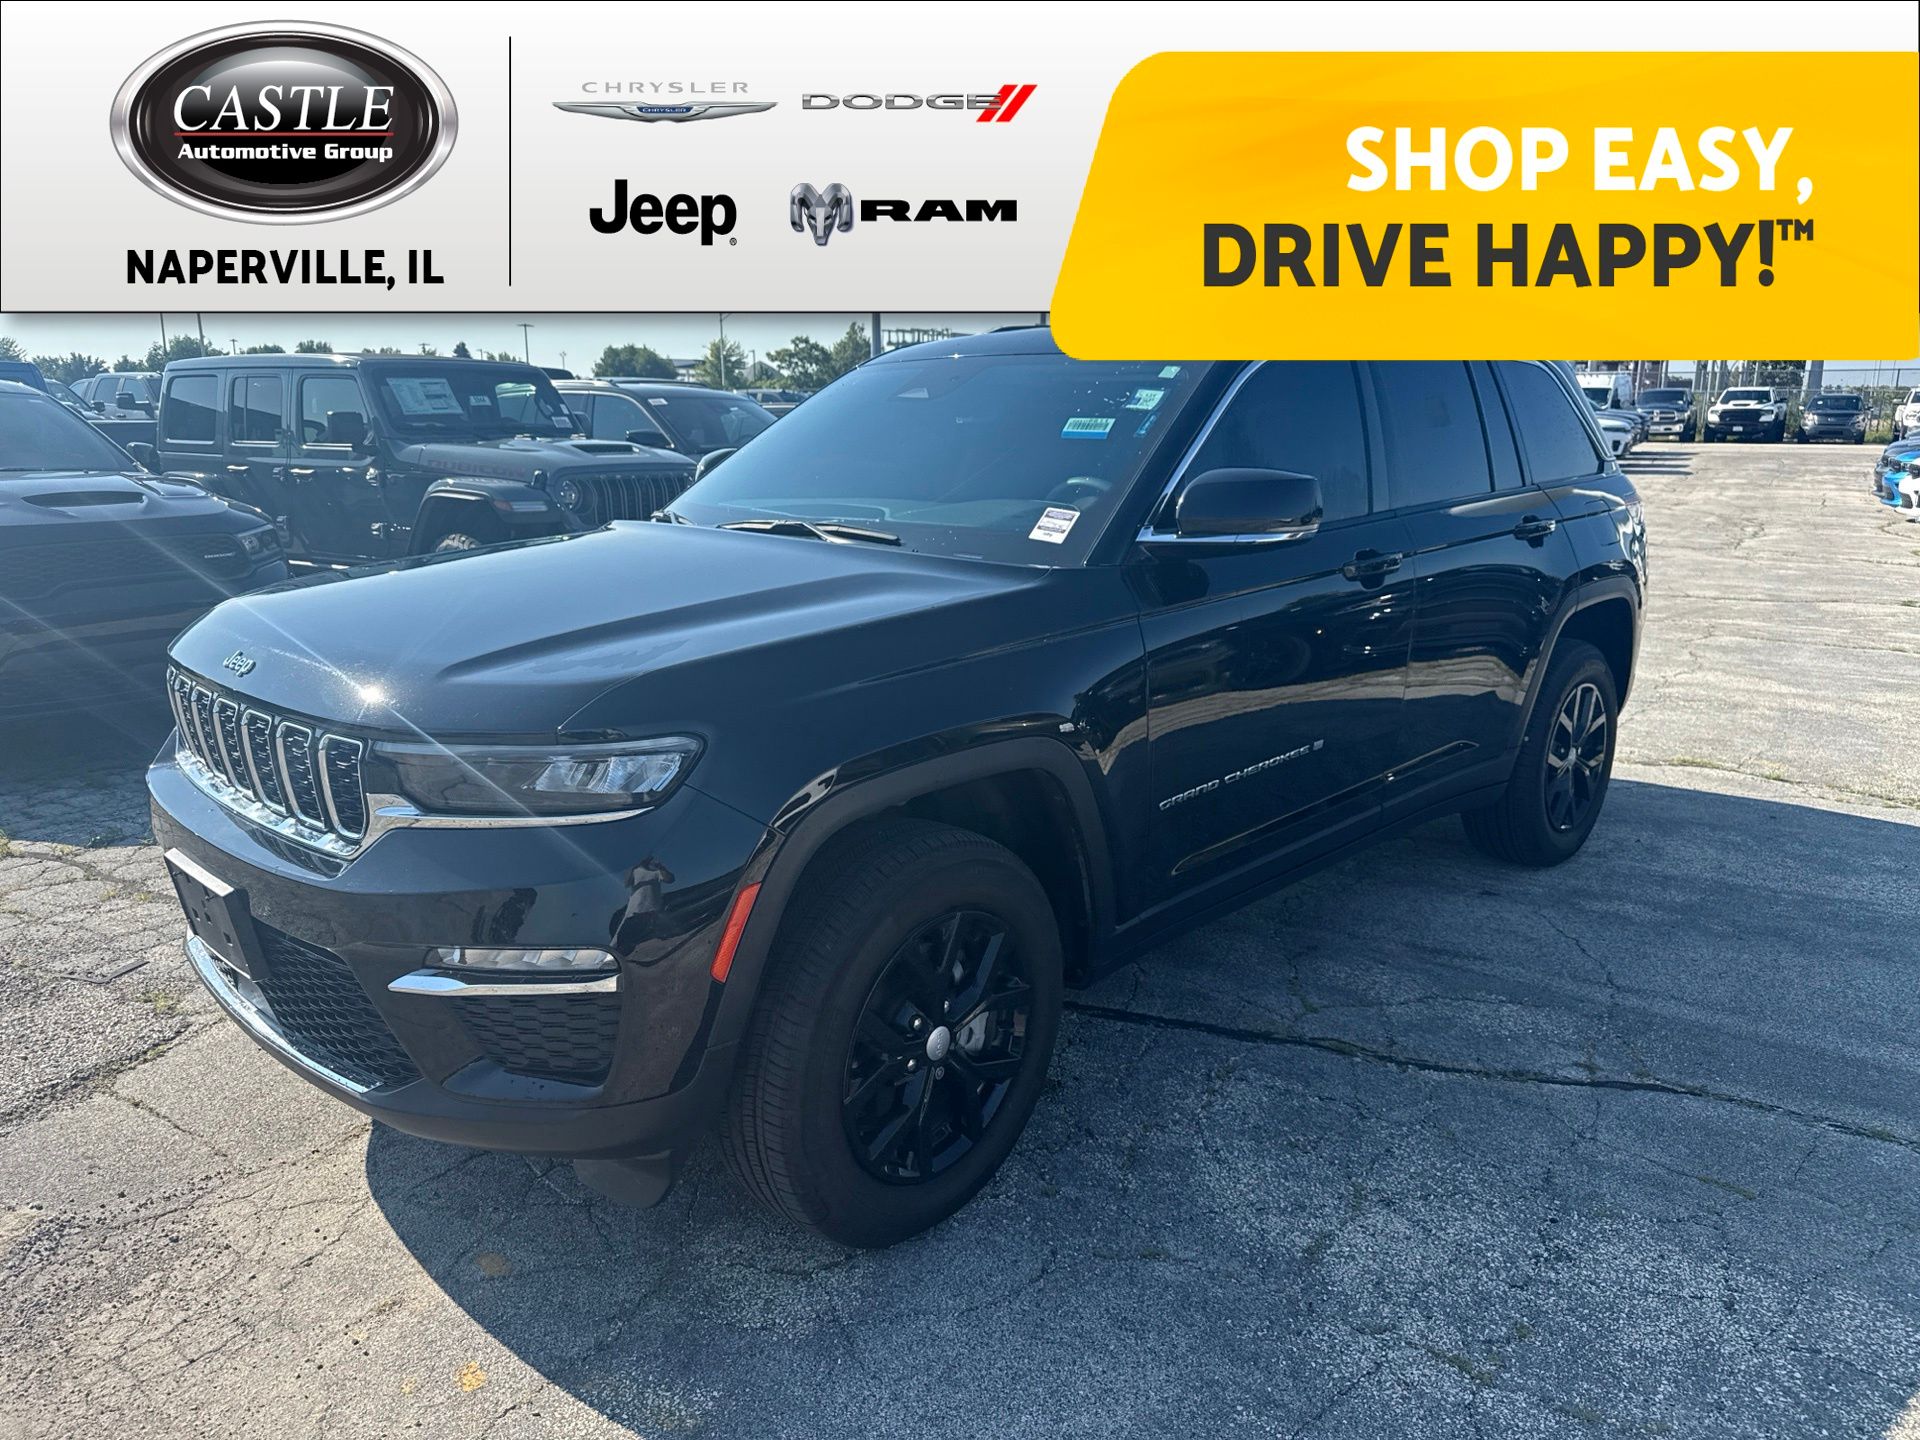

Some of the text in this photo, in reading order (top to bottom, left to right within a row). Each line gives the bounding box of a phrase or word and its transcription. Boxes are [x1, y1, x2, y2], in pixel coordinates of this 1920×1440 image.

[223, 649, 256, 678] Jeep
[1158, 744, 1310, 811] GRAND CHEROKEE
